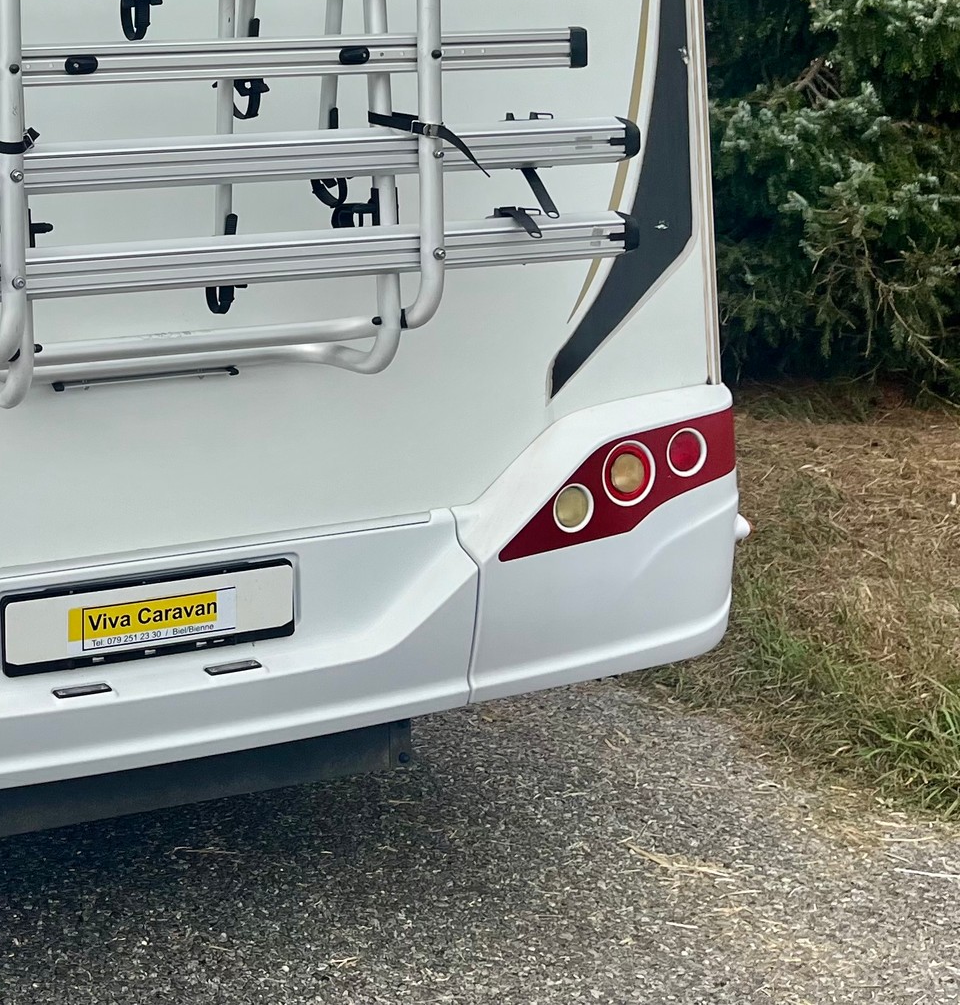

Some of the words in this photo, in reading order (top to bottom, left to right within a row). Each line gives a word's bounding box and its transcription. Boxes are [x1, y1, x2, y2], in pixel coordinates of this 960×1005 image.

[88, 612, 131, 632] Viva
[137, 601, 218, 625] Caravan
[107, 636, 122, 645] 079
[123, 633, 138, 643] 251
[140, 631, 150, 640] 23
[151, 630, 162, 638] 30
[172, 623, 215, 636] Biel/Bienne
